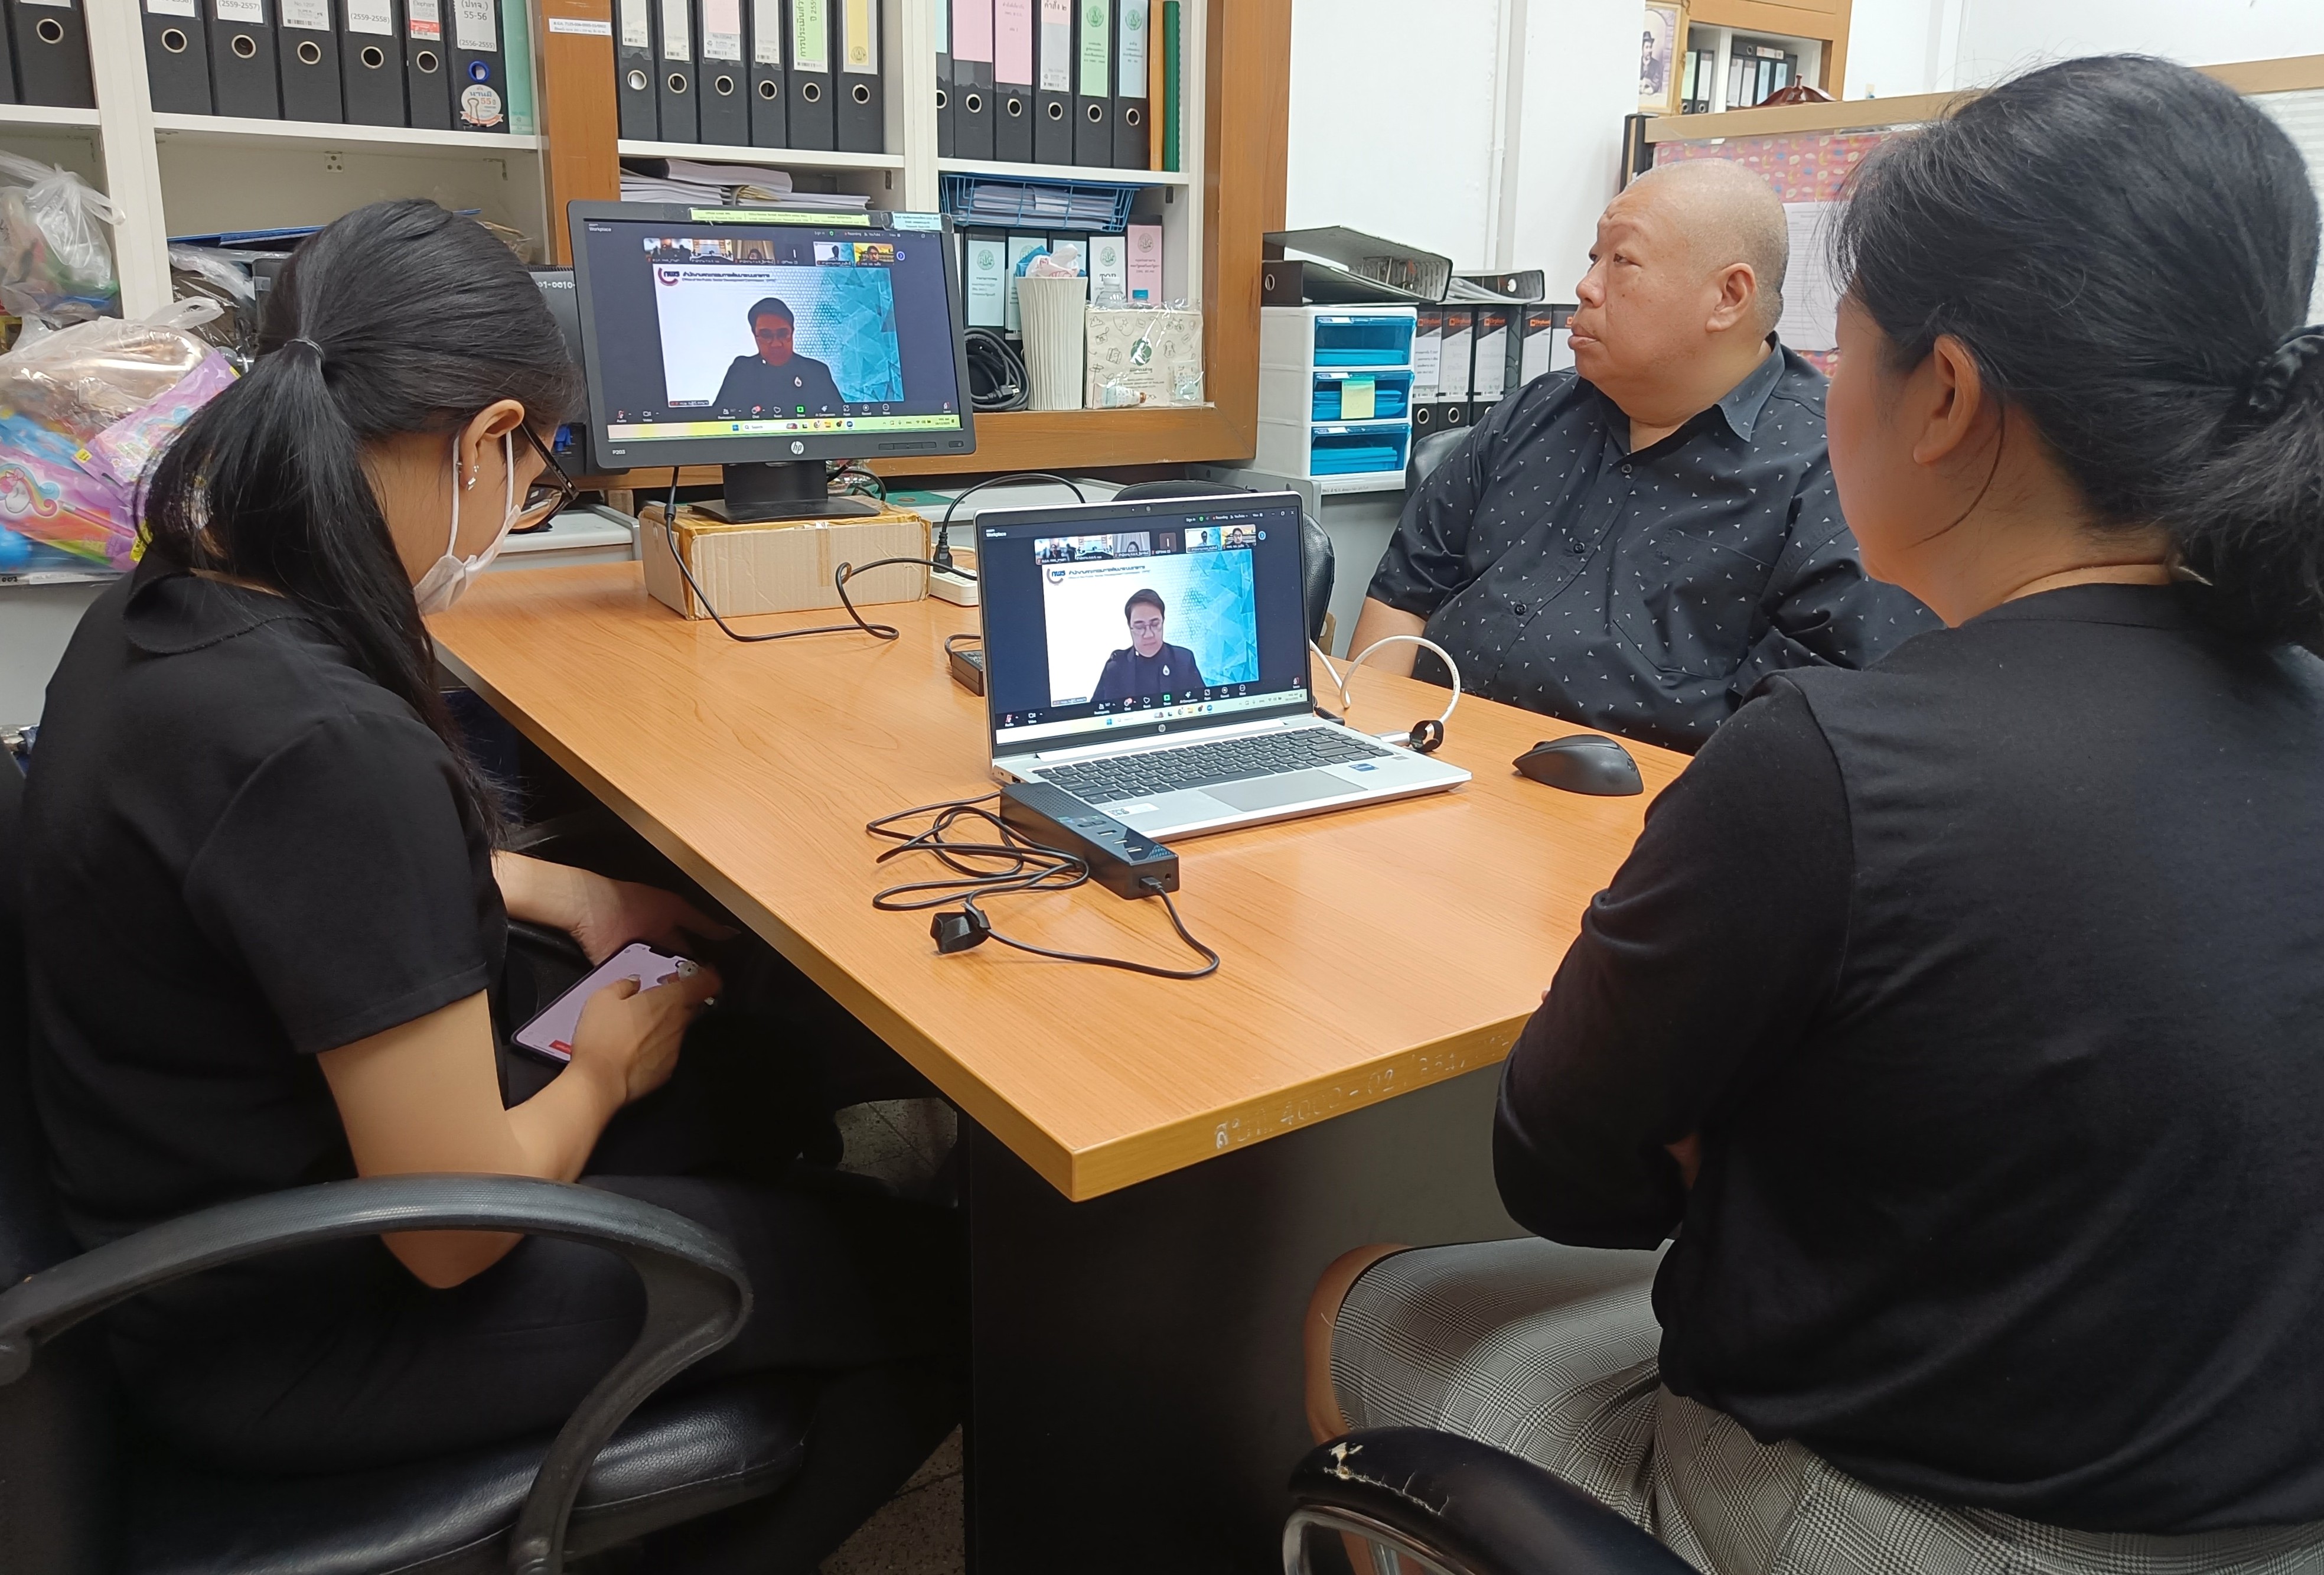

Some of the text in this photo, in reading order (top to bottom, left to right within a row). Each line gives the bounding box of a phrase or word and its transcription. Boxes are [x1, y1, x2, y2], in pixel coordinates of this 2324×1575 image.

[350, 13, 390, 24] (2559-2558)
[464, 11, 487, 21] 55-56
[459, 39, 496, 50] (2556-2555)
[791, 441, 804, 455] hp
